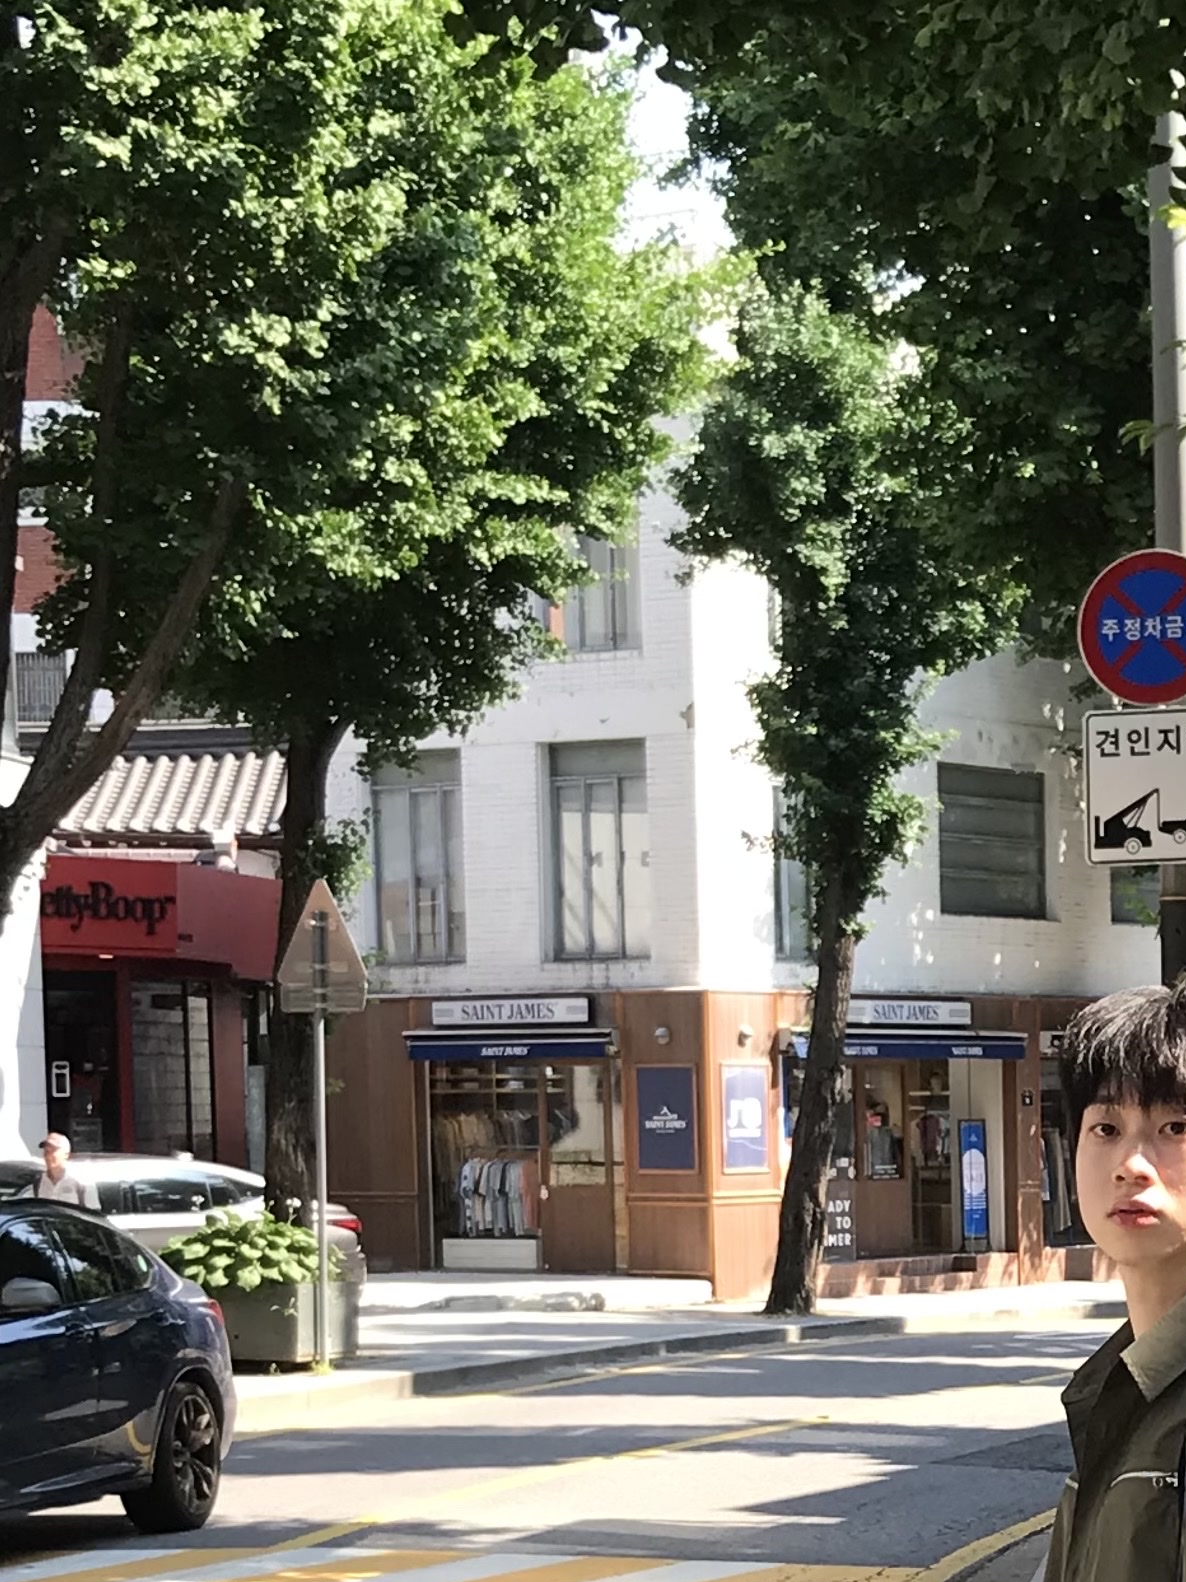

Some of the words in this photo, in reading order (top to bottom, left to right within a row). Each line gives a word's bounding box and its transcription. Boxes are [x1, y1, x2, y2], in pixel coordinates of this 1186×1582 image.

[460, 1003, 504, 1021] SAINT
[506, 1002, 556, 1020] JAMES
[873, 1003, 903, 1020] SAINT
[905, 1004, 940, 1021] JAMES
[827, 1199, 852, 1213] ADY
[835, 1216, 852, 1230] TO
[827, 1233, 852, 1247] MER
